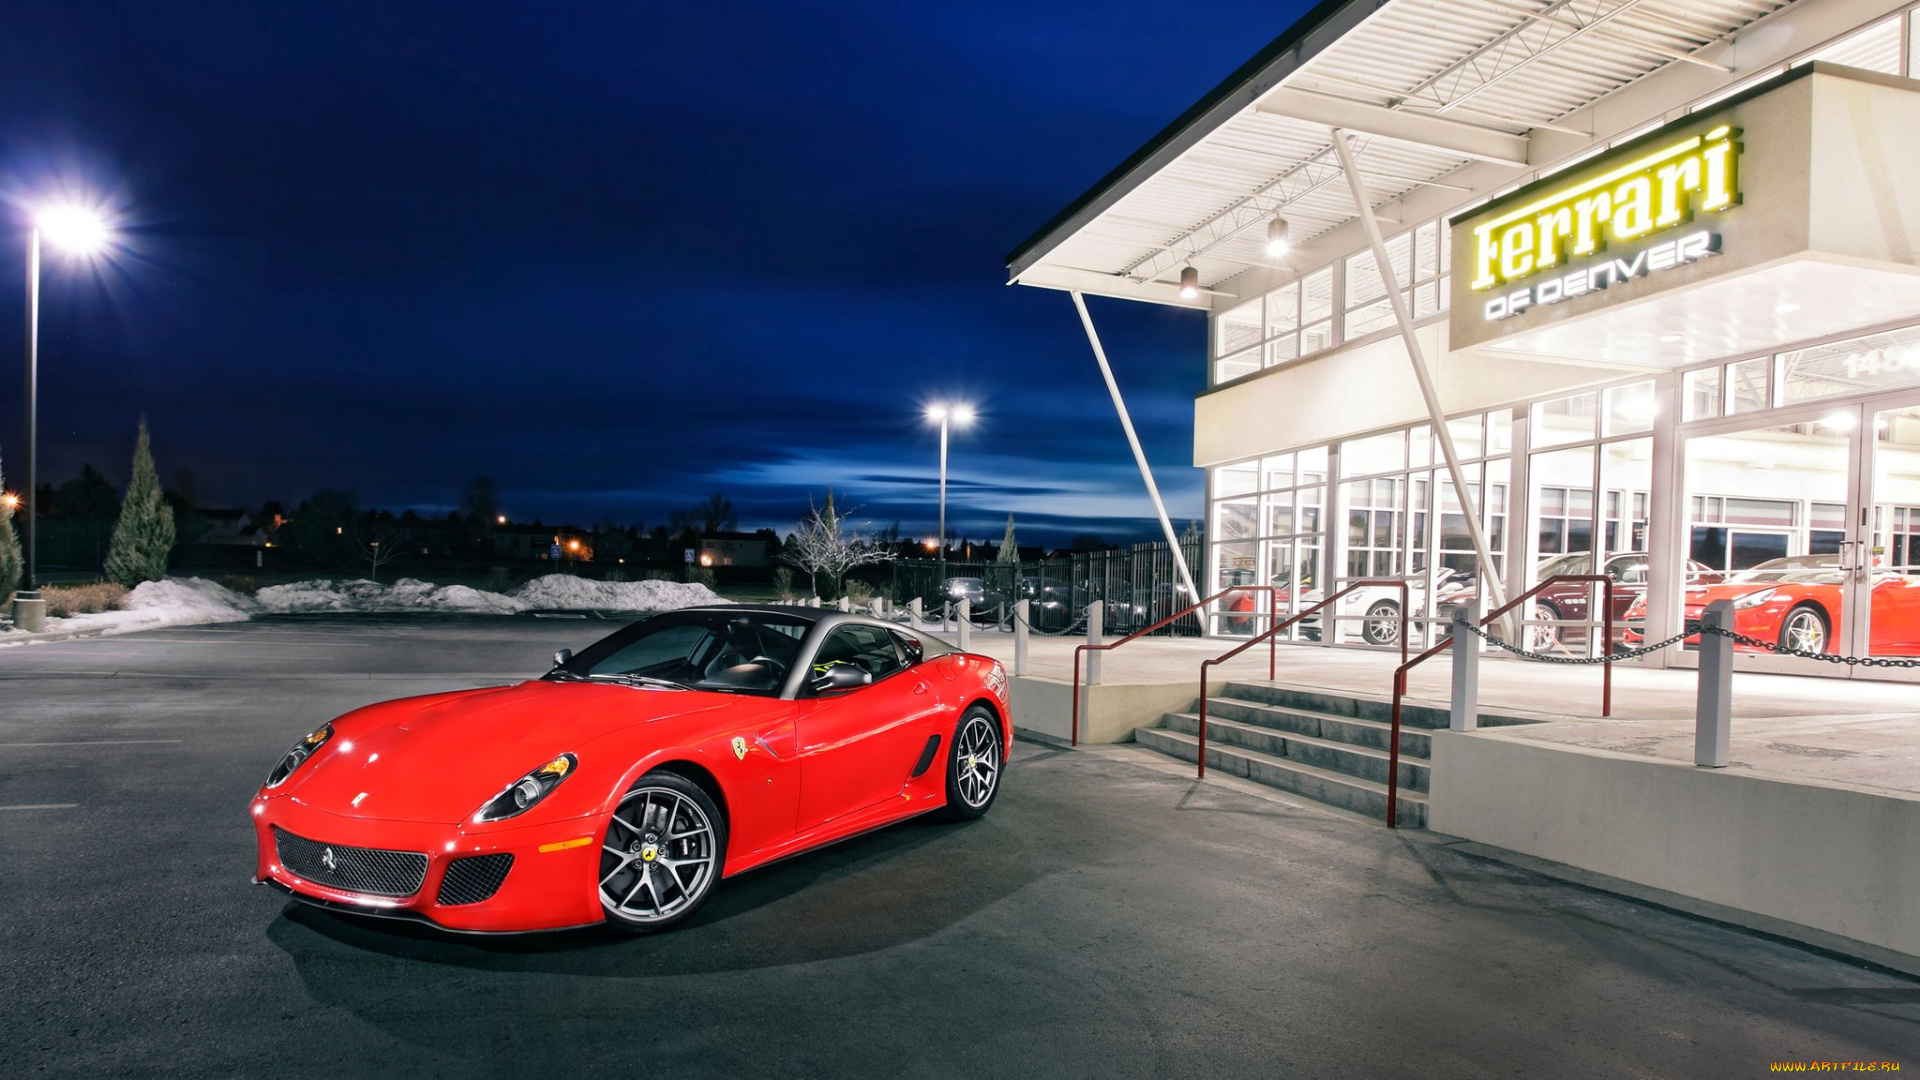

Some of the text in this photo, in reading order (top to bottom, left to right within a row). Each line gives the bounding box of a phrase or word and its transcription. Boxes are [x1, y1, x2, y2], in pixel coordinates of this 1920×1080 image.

[1471, 125, 1735, 290] Ferrari
[1485, 230, 1714, 320] OF DENVER
